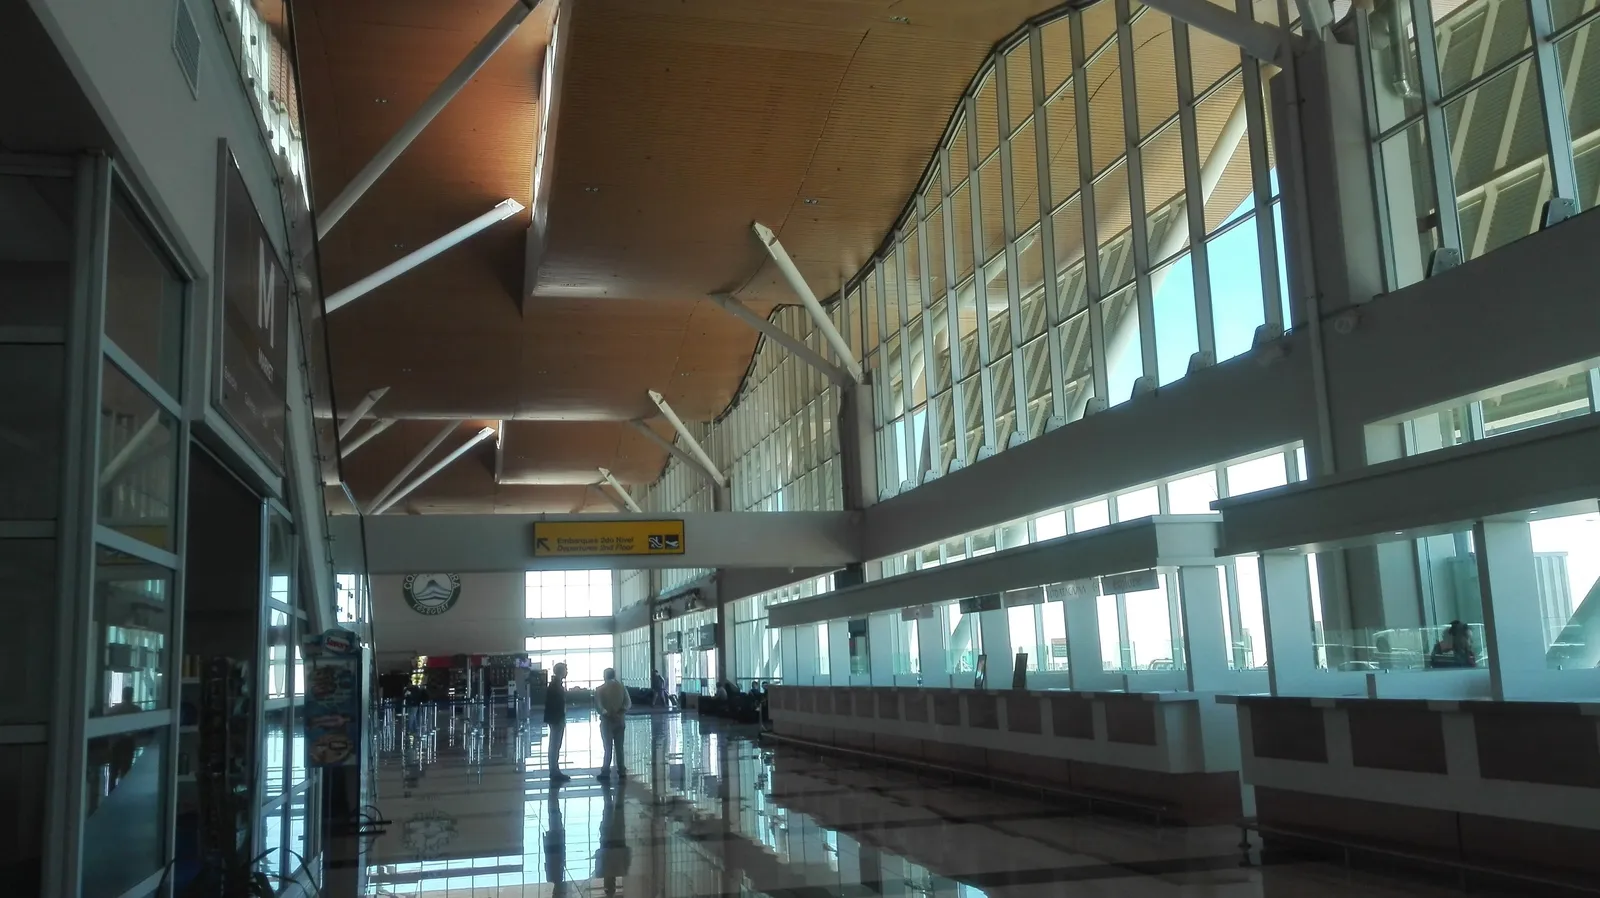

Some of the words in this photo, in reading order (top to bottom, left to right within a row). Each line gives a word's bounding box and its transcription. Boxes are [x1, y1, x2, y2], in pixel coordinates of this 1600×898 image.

[258, 236, 275, 349] M
[556, 536, 599, 545] Embarques
[600, 536, 615, 544] 2do
[616, 536, 634, 544] Nivel
[556, 545, 599, 553] Departures
[600, 544, 615, 552] 2nd
[615, 544, 635, 552] Floor
